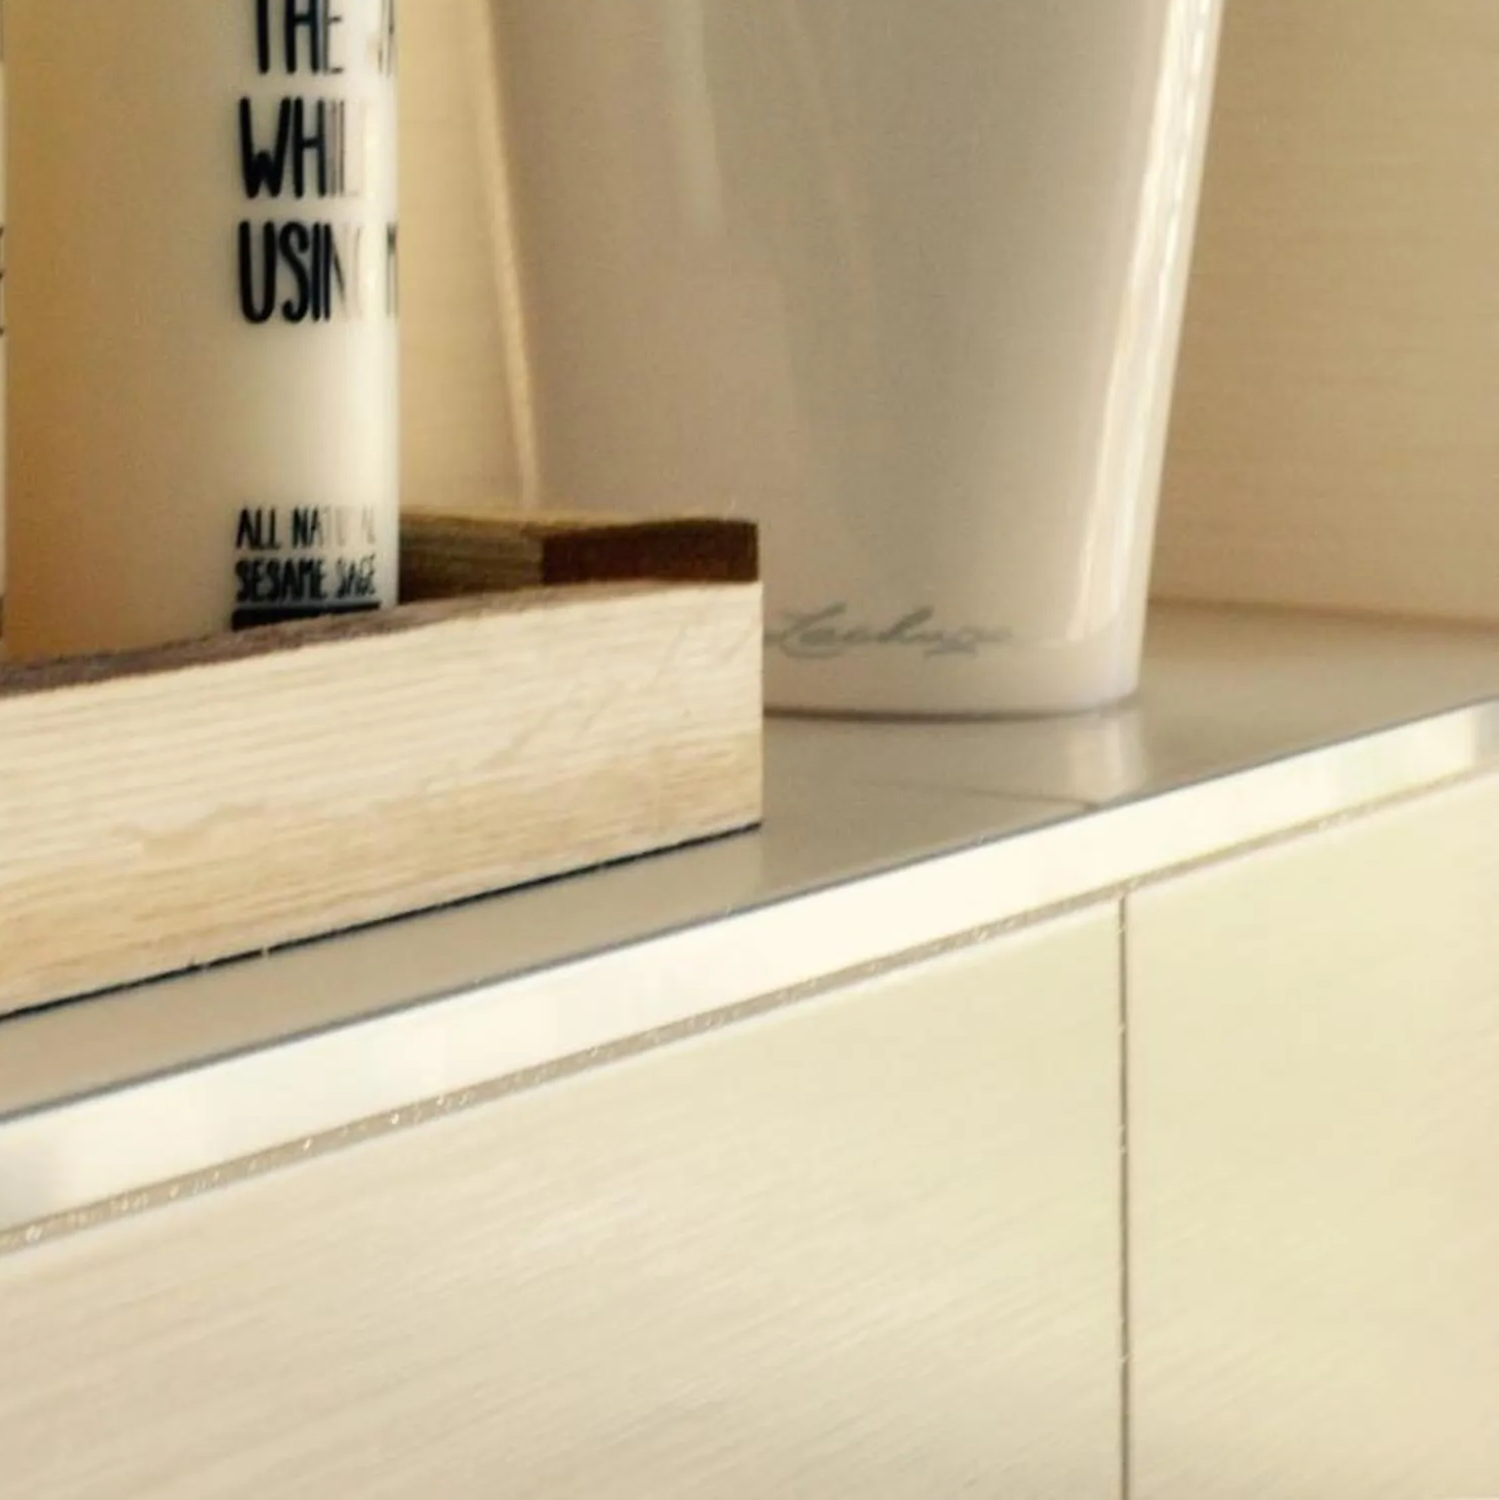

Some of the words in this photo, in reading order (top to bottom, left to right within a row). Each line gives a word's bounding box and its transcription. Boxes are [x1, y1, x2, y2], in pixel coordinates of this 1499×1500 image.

[238, 94, 362, 200] WHIL
[237, 220, 363, 325] USIN
[234, 505, 281, 551] ALL
[234, 556, 329, 602] SESAME
